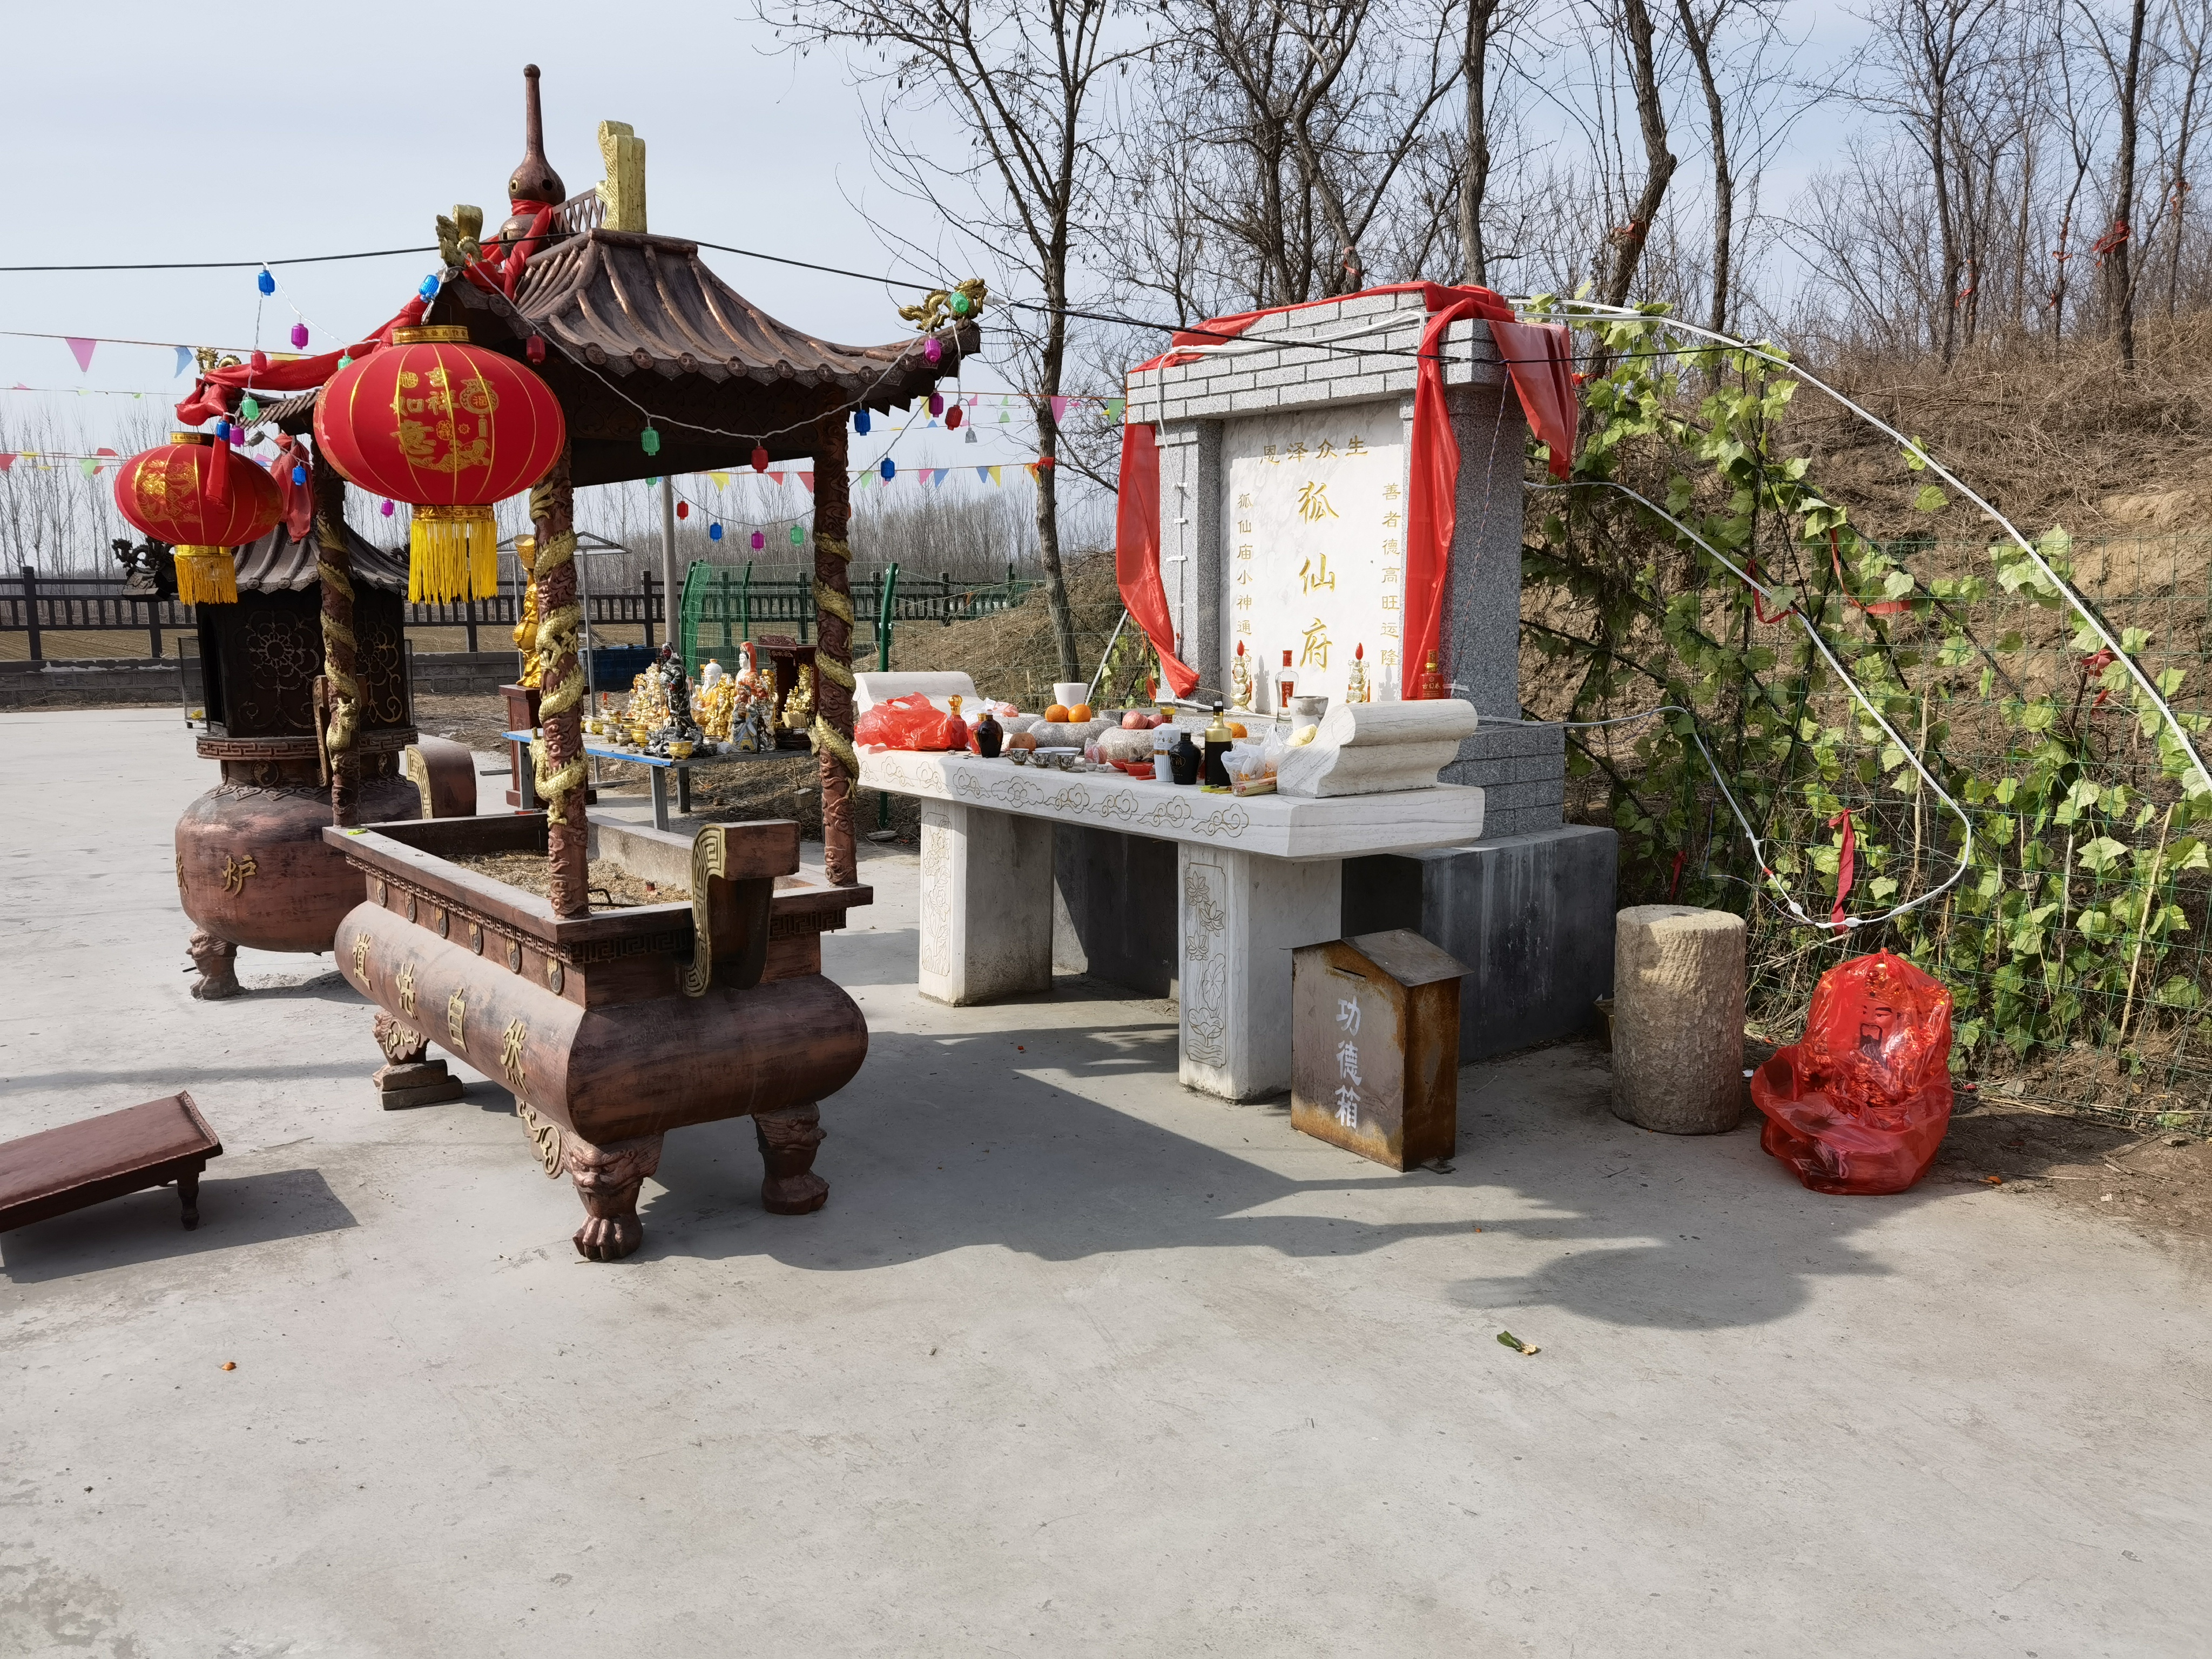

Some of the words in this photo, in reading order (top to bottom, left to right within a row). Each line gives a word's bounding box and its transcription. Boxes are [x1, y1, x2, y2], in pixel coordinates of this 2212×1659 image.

[1259, 434, 1368, 465] 恩泽众生
[1298, 481, 1339, 673] 狐仙府
[1380, 482, 1401, 666] 善者德高旺运隆
[1334, 995, 1362, 1129] 功德箱
